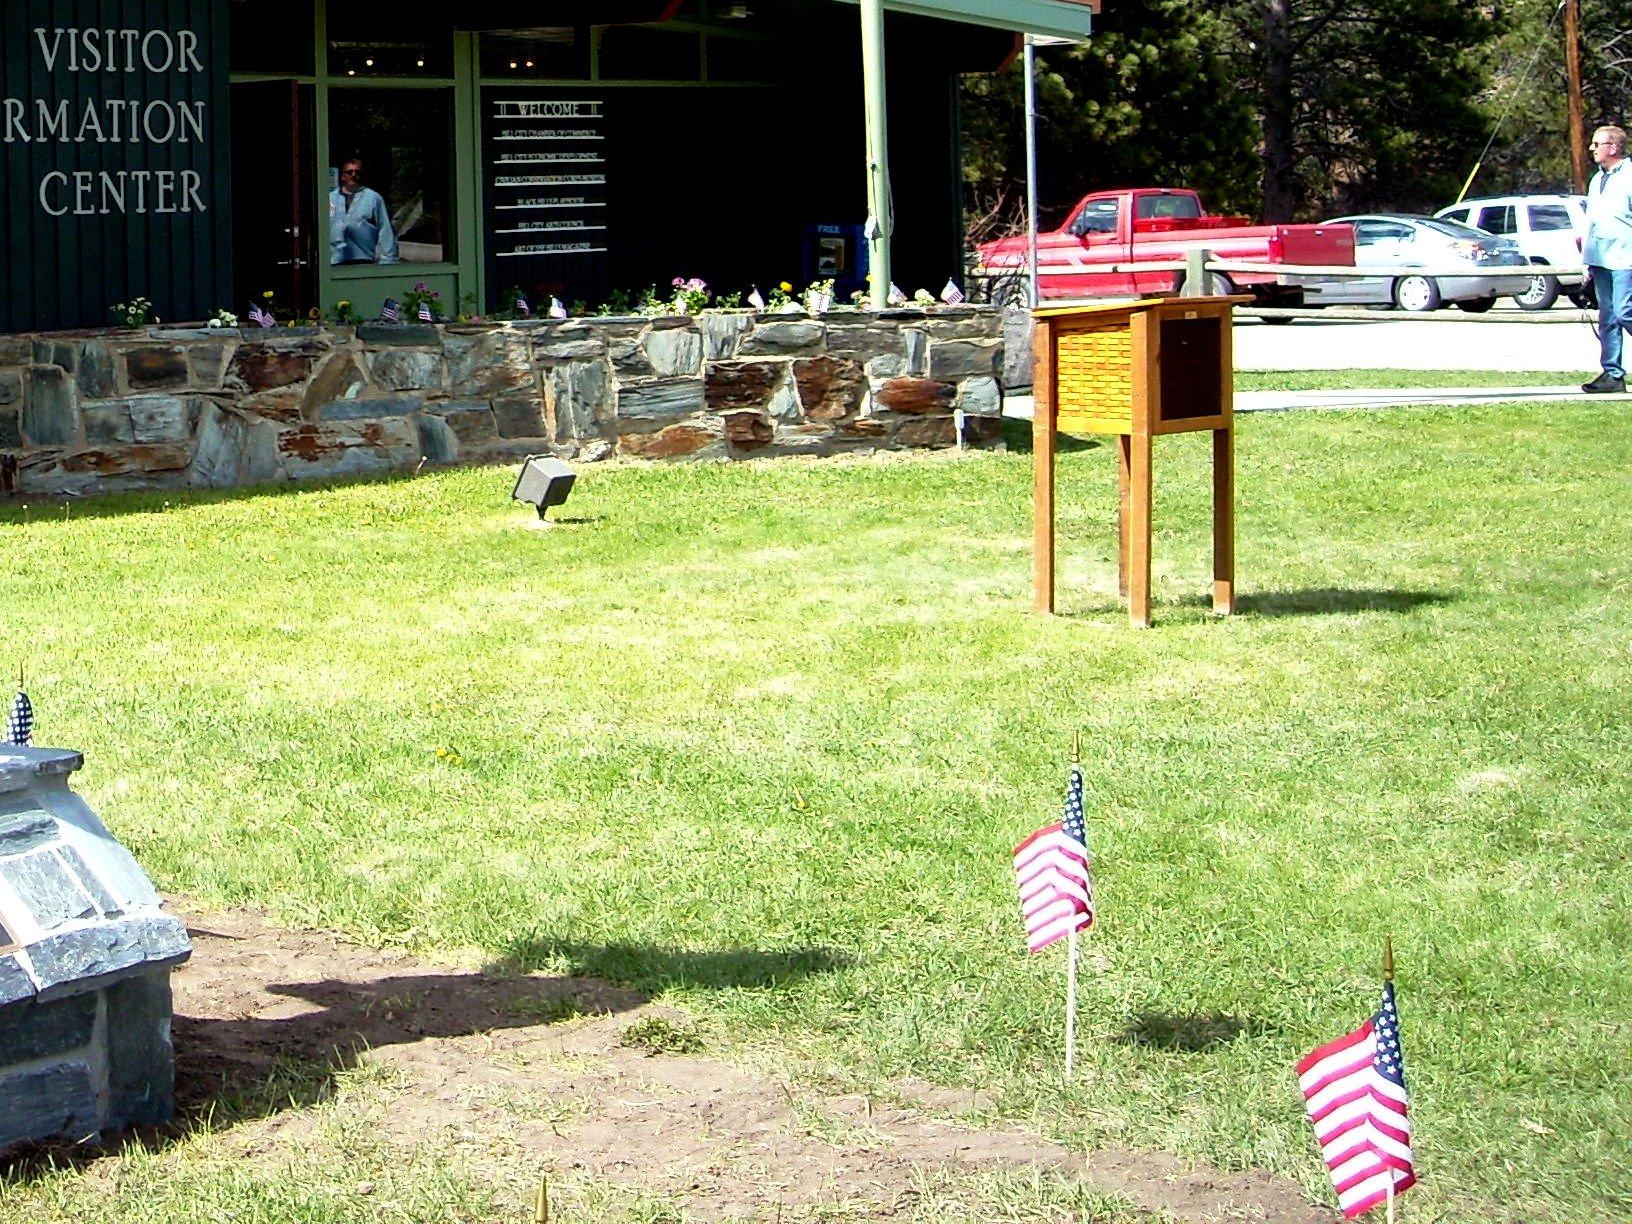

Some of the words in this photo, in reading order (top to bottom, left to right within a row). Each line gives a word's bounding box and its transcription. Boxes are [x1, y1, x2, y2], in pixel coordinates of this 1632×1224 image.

[34, 27, 204, 73] VISITOR
[518, 103, 580, 117] WELCOME
[39, 170, 207, 216] CENTER
